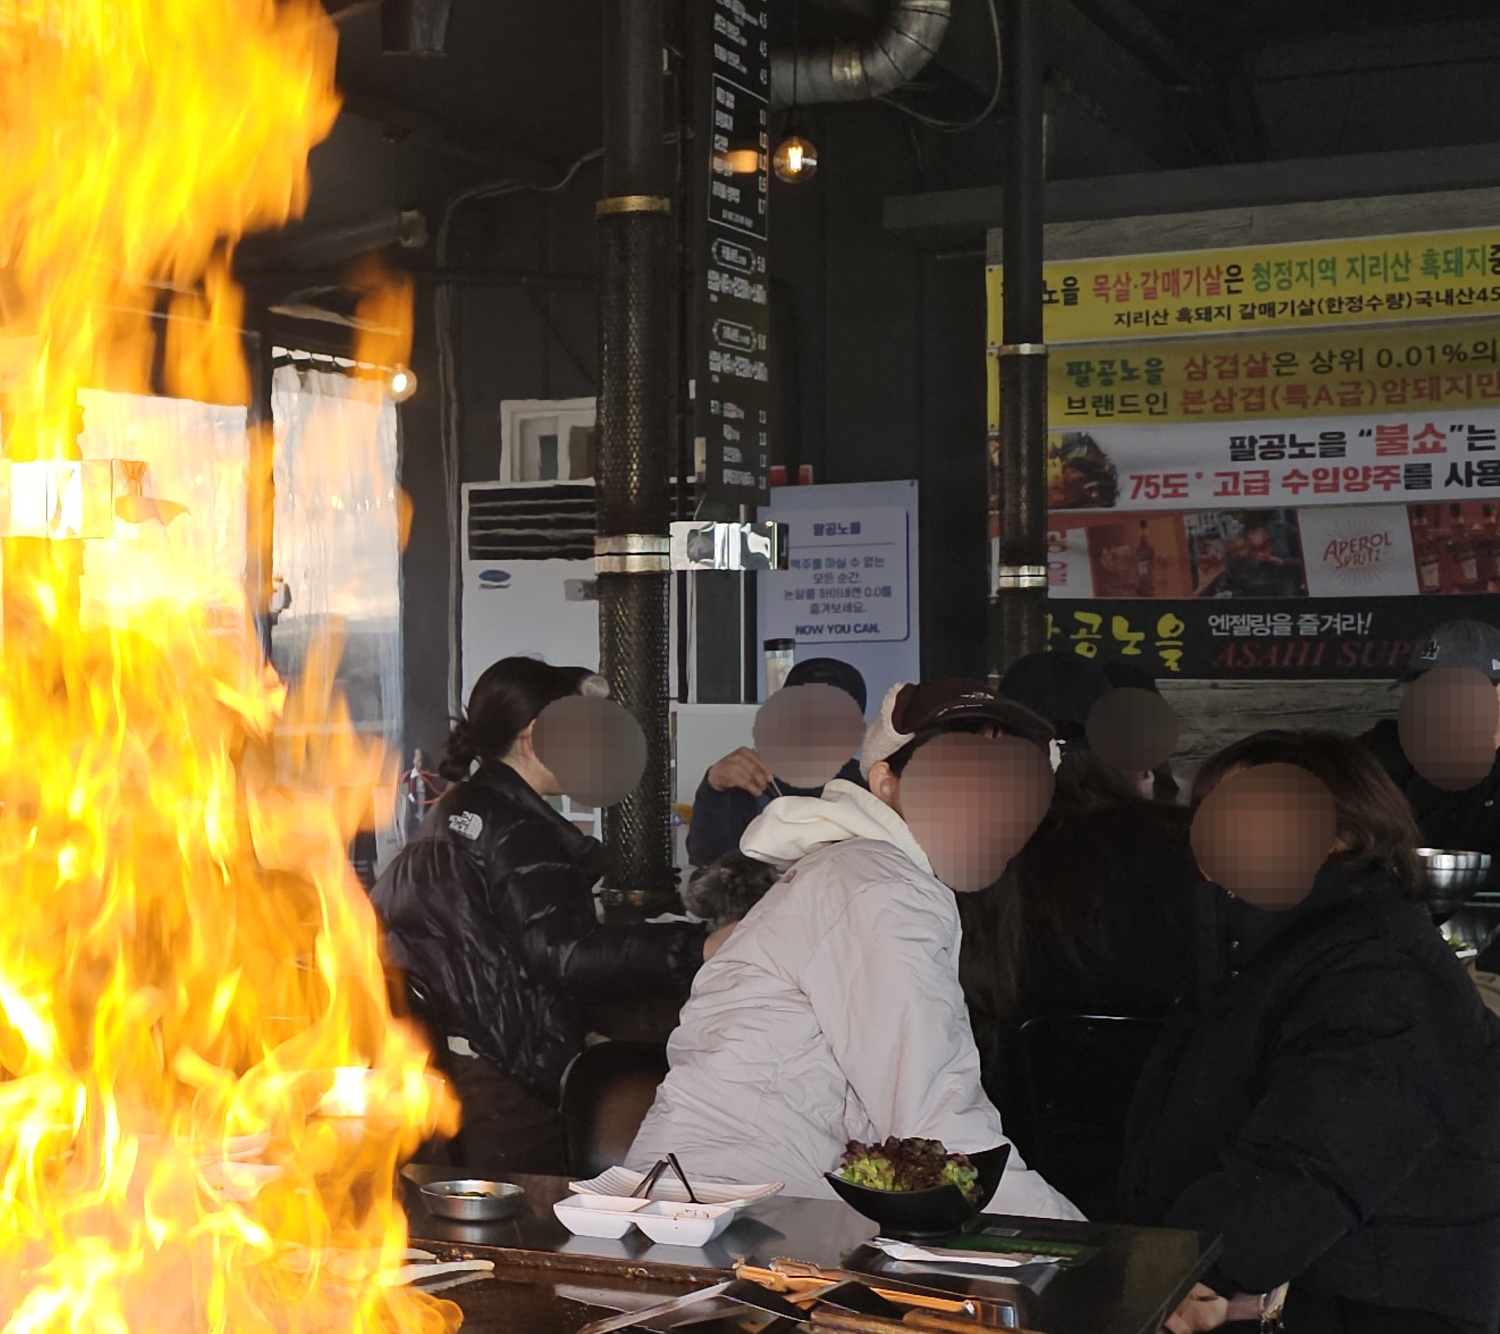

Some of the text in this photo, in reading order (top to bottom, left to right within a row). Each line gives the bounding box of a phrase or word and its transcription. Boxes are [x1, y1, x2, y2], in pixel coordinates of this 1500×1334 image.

[1251, 257, 1338, 294] 청정지역
[1346, 253, 1411, 285] 지리산
[1114, 308, 1170, 328] 지리산
[1176, 305, 1232, 324] 흑돼지
[1066, 340, 1498, 387] 팔공노을 삼겹살은 상위 0.01%의
[1064, 391, 1169, 417] 브랜드인
[1229, 431, 1347, 461] 팔공노을
[1214, 471, 1270, 496] 고급
[1282, 462, 1432, 494] 수입양주를
[1324, 531, 1392, 561] APEROL
[795, 622, 880, 635] NOW YOU CAN.
[1208, 613, 1293, 638] 엔젤링을
[1297, 612, 1372, 637] 즐겨라!
[1212, 641, 1329, 668] ASAHI
